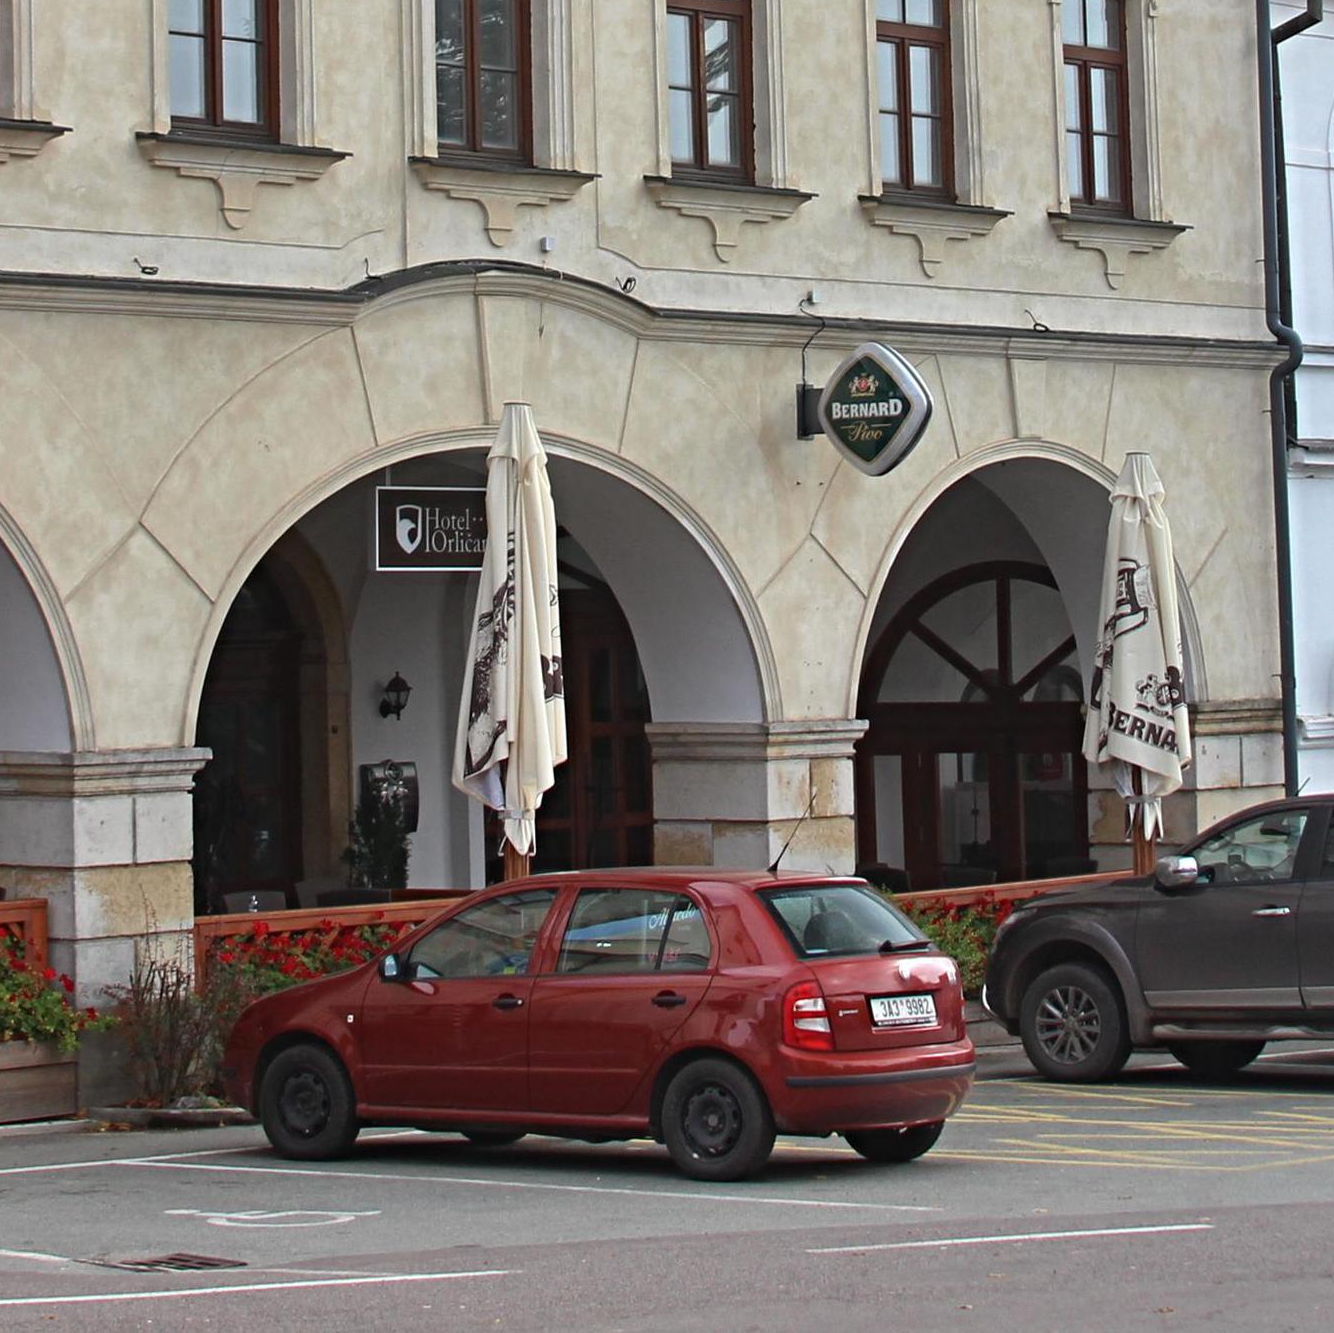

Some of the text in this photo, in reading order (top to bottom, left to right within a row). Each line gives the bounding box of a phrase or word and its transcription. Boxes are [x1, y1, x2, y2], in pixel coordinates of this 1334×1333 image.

[832, 398, 903, 420] BERNARD
[849, 421, 883, 442] Pivo
[425, 507, 470, 531] Hotel
[880, 999, 900, 1017] 3A3
[906, 998, 934, 1016] 9982
